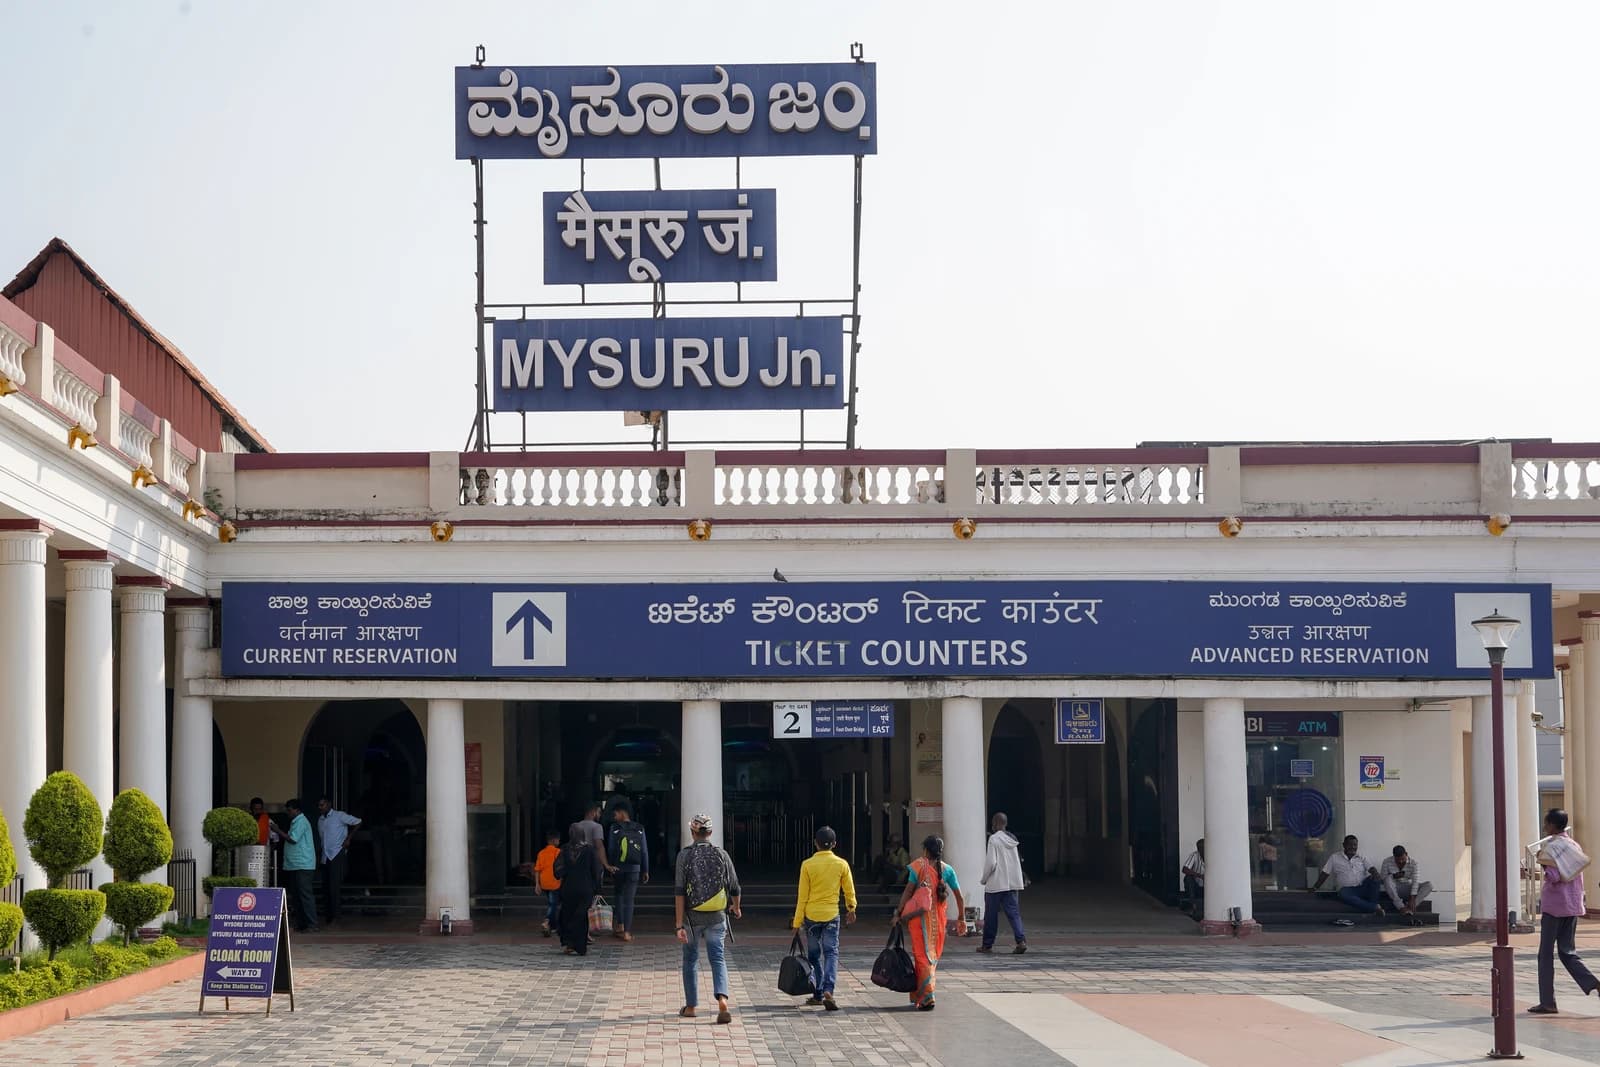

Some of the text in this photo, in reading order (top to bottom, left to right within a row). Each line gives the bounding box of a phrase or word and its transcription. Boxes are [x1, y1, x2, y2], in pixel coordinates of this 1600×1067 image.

[467, 66, 871, 158] ಮೈಸೂರು ಜಂ.
[557, 190, 763, 282] मैसूरु जं.
[501, 337, 837, 390] MYSURU Jn.
[648, 591, 1103, 625] ಟಿಕೆಟ್ ಕೌಂಟರ್ टिकट काउंटर
[1209, 592, 1280, 608] ಮುಂಗಡ
[279, 619, 423, 642] वर्तमान आरक्षण
[1248, 624, 1372, 641] उन्नत आरक्षण
[243, 648, 457, 665] CURRENT RESERVATION
[745, 639, 1028, 666] TICKET COUNTERS
[1190, 647, 1429, 665] ADVANCED RESERVATION
[783, 711, 801, 734] 2
[872, 725, 890, 734] EAST
[1246, 717, 1263, 732] BI
[1298, 721, 1327, 733] ATM
[210, 949, 272, 963] CLOAK ROOM
